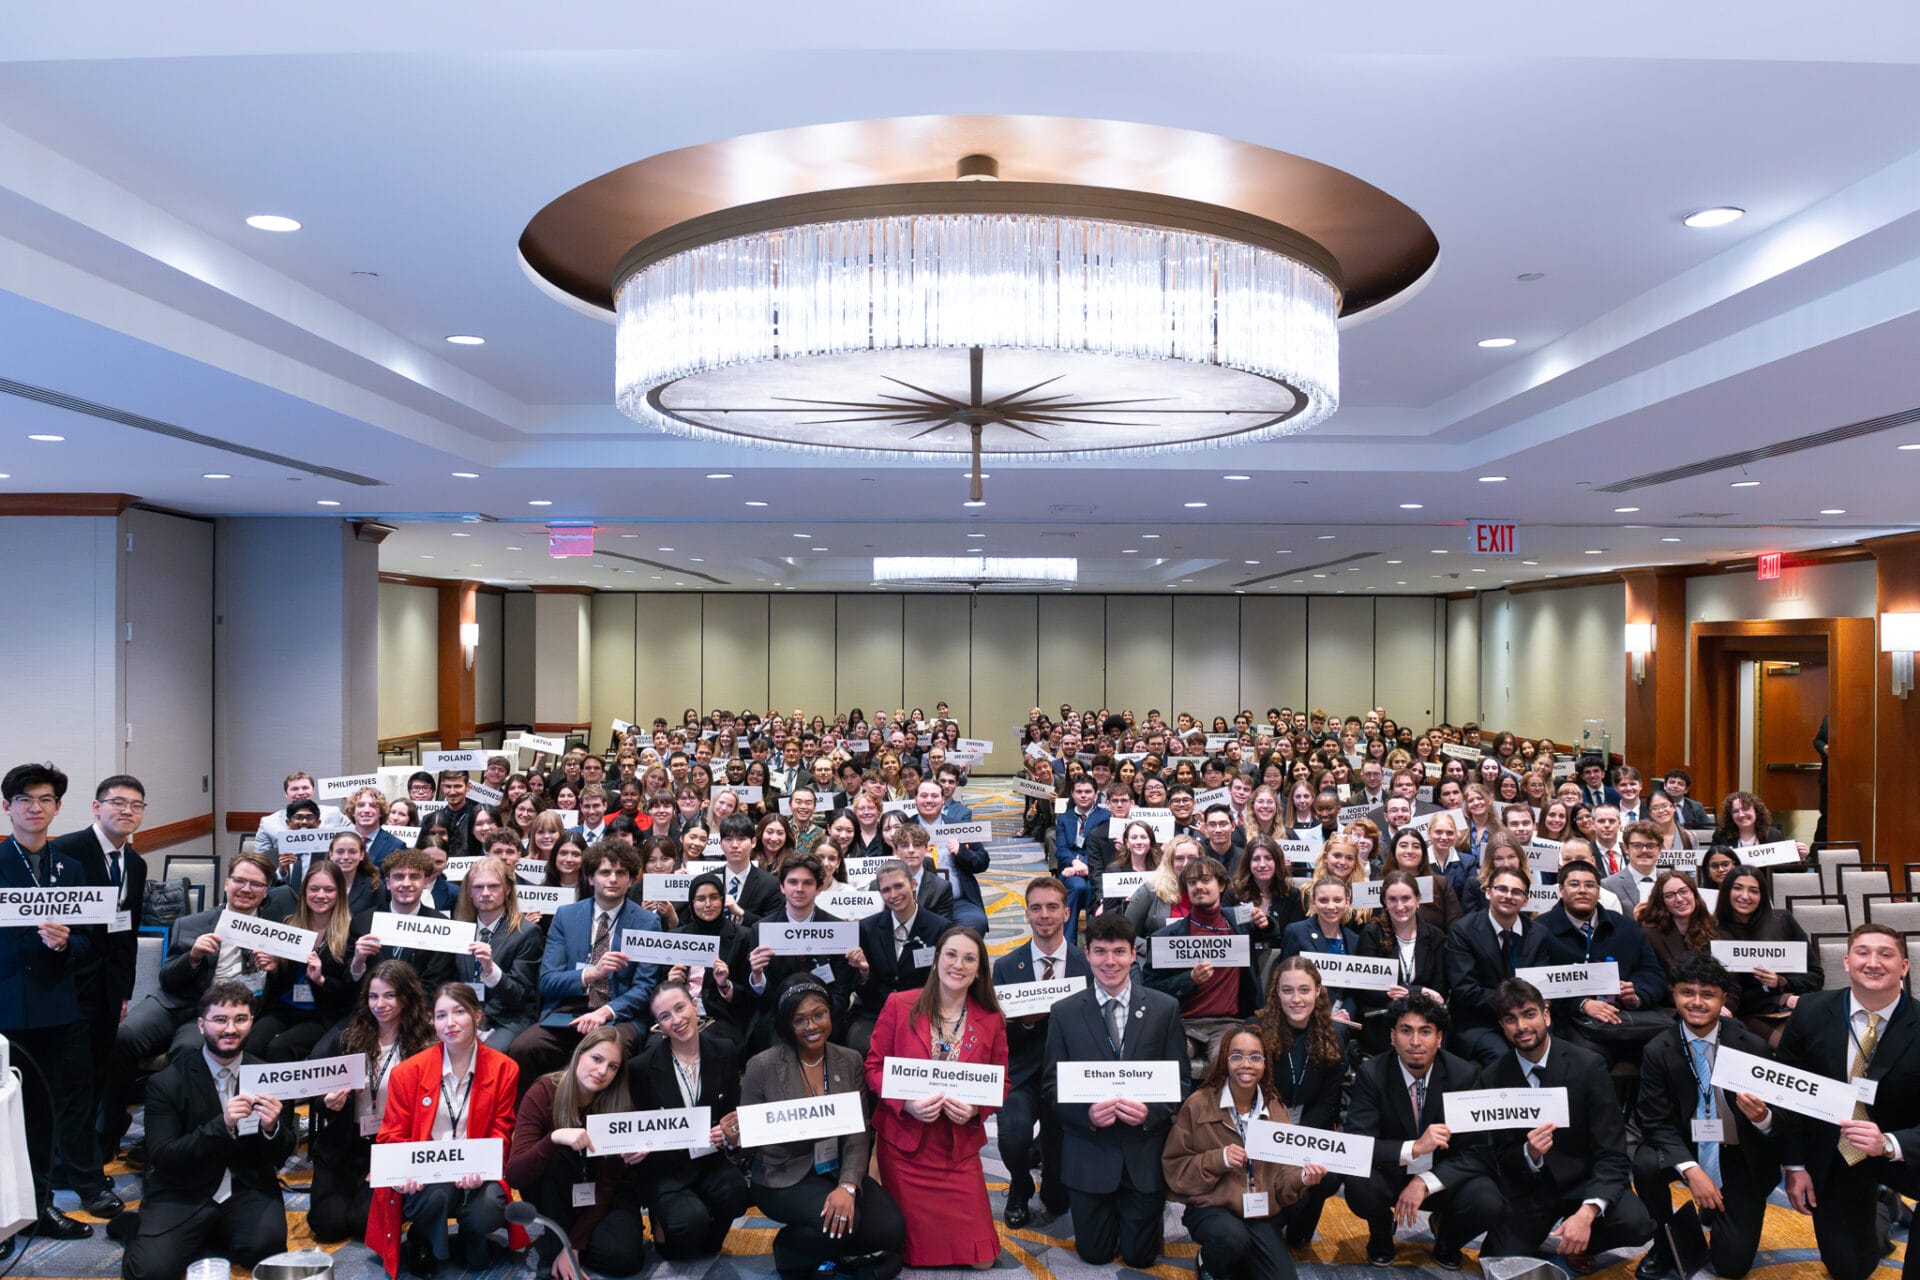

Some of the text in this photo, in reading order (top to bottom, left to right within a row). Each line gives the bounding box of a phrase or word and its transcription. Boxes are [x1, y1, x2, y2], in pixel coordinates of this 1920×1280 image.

[1477, 524, 1516, 553] EXIT
[532, 737, 553, 747] LATVIA
[438, 754, 472, 762] POLAND
[327, 777, 377, 790] PHILIPPINES
[1019, 782, 1046, 793] SLOVAKIA
[1196, 792, 1224, 804] ENMARK
[903, 803, 916, 811] PER
[1347, 806, 1370, 815] NORTH
[1339, 812, 1368, 820] MACEDO
[936, 826, 982, 836] MOROCCO
[286, 833, 314, 844] CABO
[1283, 844, 1311, 852] GARIA
[1748, 847, 1776, 857] EGYPT
[1660, 851, 1697, 859] STATE OF
[664, 879, 690, 888] LIBER
[1117, 877, 1143, 886] JAMA
[0, 890, 104, 904] EQUATORIAL
[517, 890, 559, 902] ALDIVES
[831, 896, 874, 906] ALGERIA
[1529, 890, 1559, 900] NISIA
[19, 903, 82, 916] GUINEA
[230, 919, 303, 946] SINGAPORE
[396, 920, 451, 937] FINLAND
[784, 929, 834, 940] CYPRUS
[626, 935, 716, 954] MADAGASCAR
[1168, 938, 1233, 950] SOLOMON
[1175, 948, 1227, 960] ISLANDS
[1732, 947, 1786, 959] BURUNDI
[1314, 959, 1393, 977] AUDI ARABIA
[1546, 970, 1588, 984] YEMEN
[997, 984, 1071, 1000] éo Jaussaud
[257, 1063, 348, 1085] ARGENTINA
[891, 1064, 998, 1083] Maria Ruedisueli
[1084, 1069, 1153, 1080] Ethan Solury
[1751, 1065, 1819, 1097] GREECE
[765, 1103, 836, 1125] BAHRAIN
[1470, 1107, 1541, 1122] ARMENIA
[608, 1116, 690, 1135] SRI LANKA
[1272, 1130, 1347, 1155] GEORGIA
[411, 1148, 465, 1165] ISRAEL
